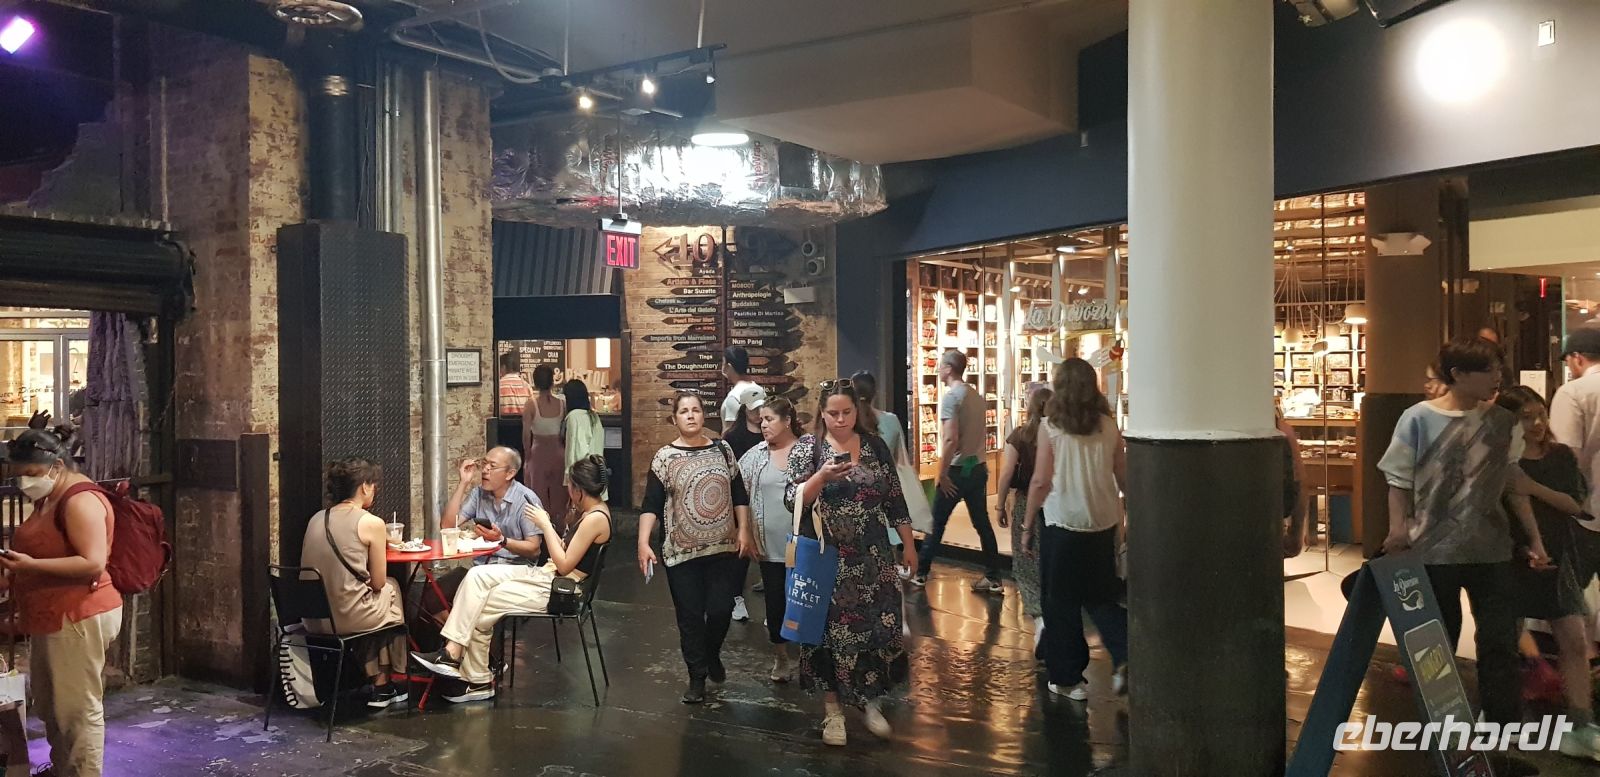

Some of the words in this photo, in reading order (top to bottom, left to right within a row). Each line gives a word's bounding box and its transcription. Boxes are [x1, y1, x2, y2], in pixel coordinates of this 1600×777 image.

[606, 233, 636, 267] EXIT
[672, 232, 716, 266] 10
[747, 338, 763, 346] Pang
[553, 367, 564, 384] &
